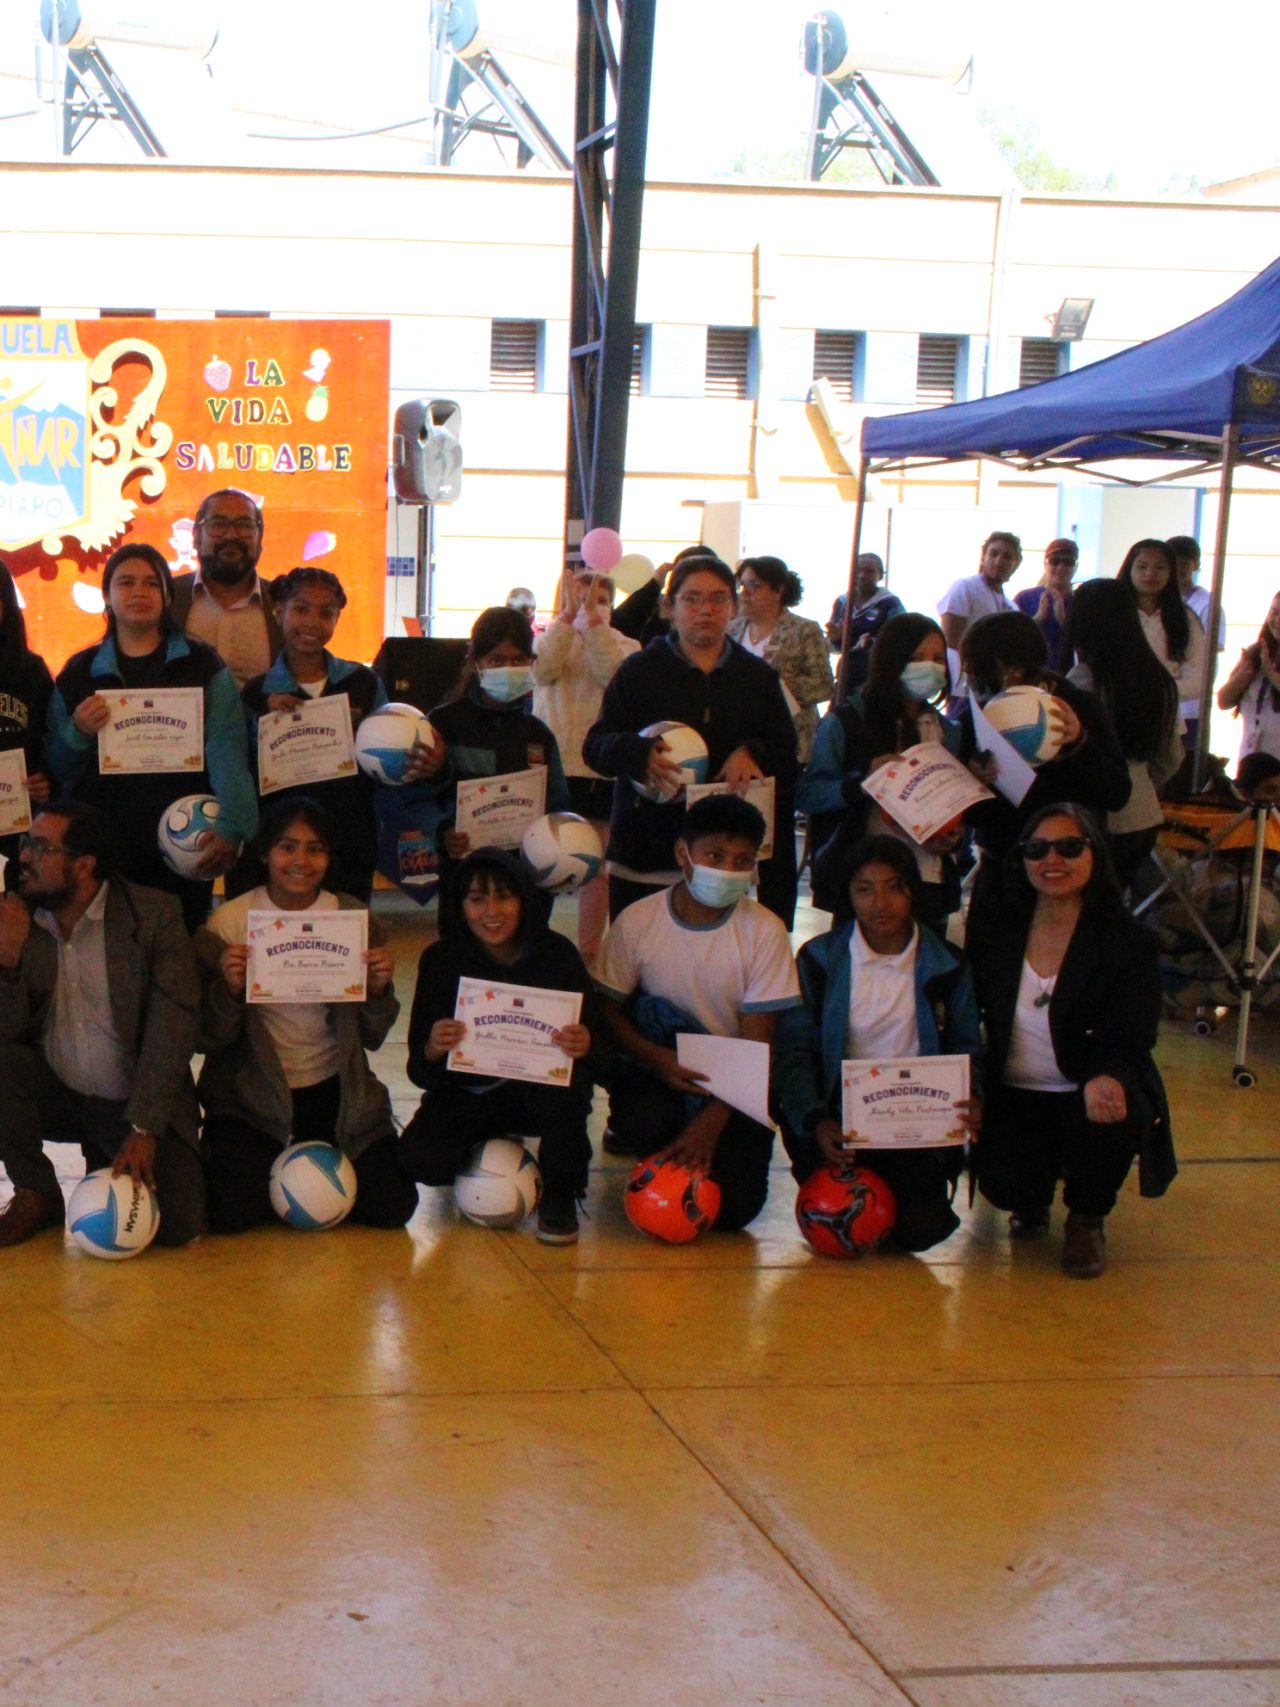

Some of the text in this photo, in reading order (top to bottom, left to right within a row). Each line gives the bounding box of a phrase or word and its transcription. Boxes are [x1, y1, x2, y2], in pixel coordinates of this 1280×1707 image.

[245, 359, 286, 386] LA
[205, 396, 291, 425] VIDA
[176, 441, 352, 473] SALUDABLE
[114, 715, 187, 731] RECONOCIMIENTO
[269, 726, 336, 750] RECONOCIMIENTO
[266, 940, 350, 957] RECONOCIMIENTO
[862, 1086, 950, 1104] RECONOCIMIENTO
